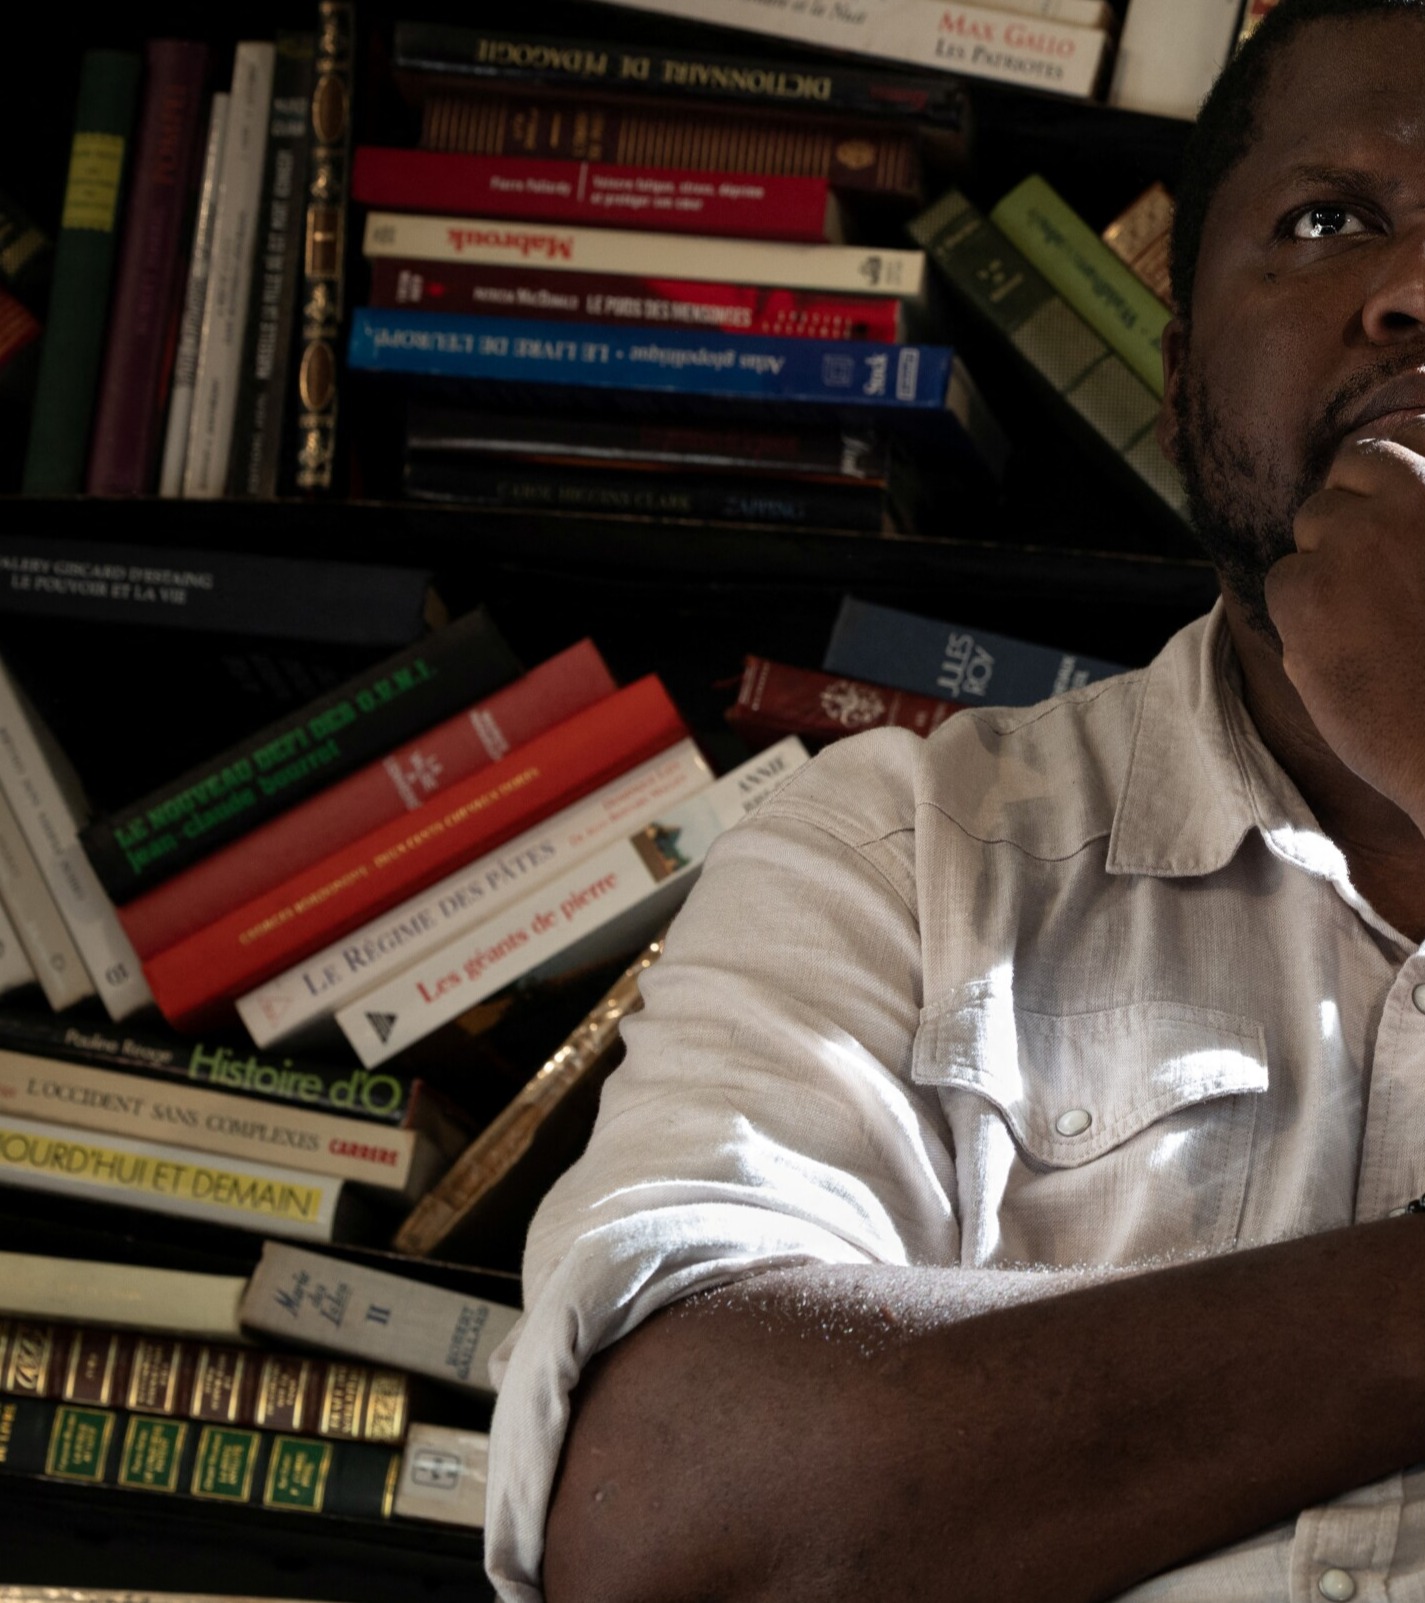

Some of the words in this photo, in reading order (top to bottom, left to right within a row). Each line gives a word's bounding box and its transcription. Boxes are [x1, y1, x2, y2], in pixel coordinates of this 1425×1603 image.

[933, 39, 964, 62] LES
[937, 11, 996, 42] MAX
[1002, 23, 1078, 58] GALLO
[618, 54, 650, 82] DE
[662, 60, 832, 100] DICTIONNAIRE
[444, 227, 574, 260] Mabrouk
[478, 334, 509, 357] DE
[514, 337, 577, 361] LIVRE
[582, 342, 608, 363] LE
[739, 351, 784, 375] Atlas
[52, 560, 127, 582] GISCARD
[10, 573, 32, 591] LE
[33, 576, 108, 597] POUVOIR
[109, 581, 129, 599] ET
[133, 582, 156, 601] LA
[157, 585, 187, 605] VIE
[962, 643, 997, 698] ROY
[110, 814, 151, 851] LE
[143, 754, 257, 833] NOUVEAU
[303, 696, 360, 743] DES
[732, 752, 790, 796] ANNIE
[413, 962, 464, 1005] Les
[457, 923, 534, 982] géants
[525, 904, 560, 938] de
[555, 868, 624, 922] pierre
[62, 1025, 120, 1055] Pauline
[186, 1040, 327, 1106] Histoire
[326, 1064, 406, 1121] d'O
[149, 1102, 199, 1128] SANS
[204, 1115, 320, 1152] COMPLEXES
[327, 1138, 399, 1167] CARRERE
[151, 1160, 192, 1194] ET
[190, 1169, 313, 1217] DEMAIN
[268, 1262, 314, 1319] Marie
[364, 1302, 390, 1326] II
